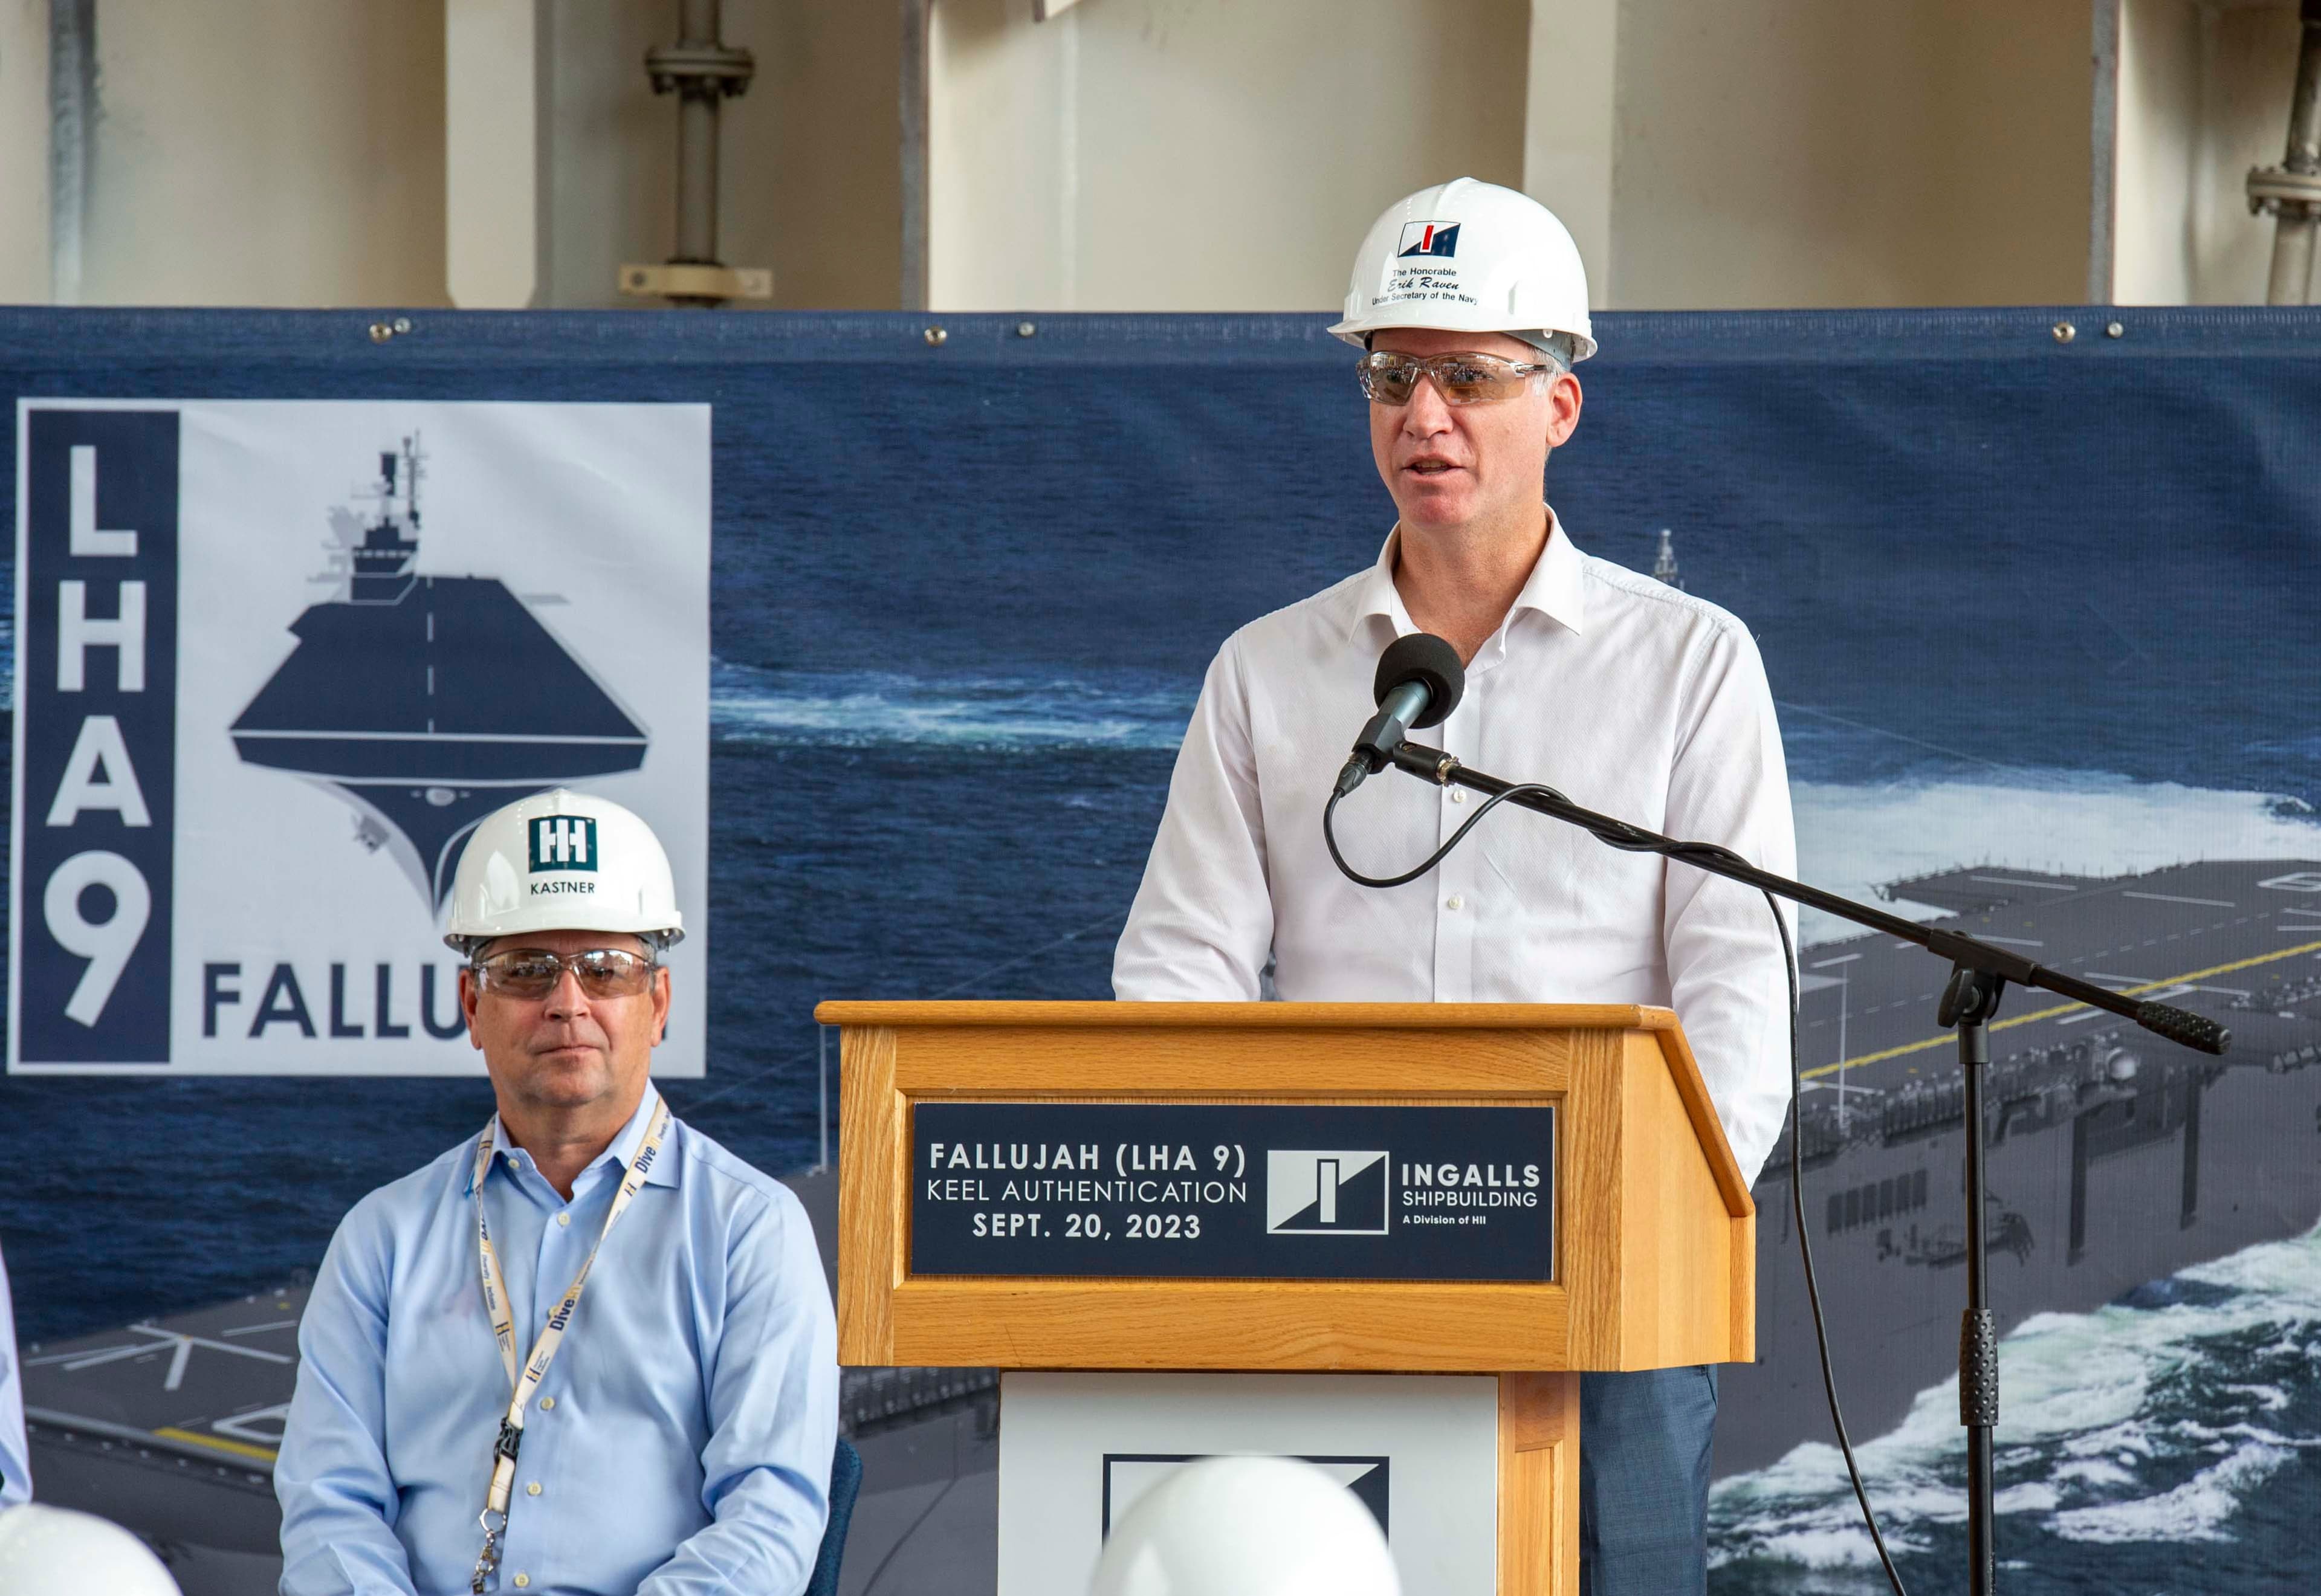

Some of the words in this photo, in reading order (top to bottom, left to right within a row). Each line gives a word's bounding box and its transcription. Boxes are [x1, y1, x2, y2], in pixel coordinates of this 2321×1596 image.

[1410, 267, 1457, 276] Honorable
[1387, 277, 1414, 292] Erik
[1419, 276, 1460, 290] Raven
[1372, 295, 1390, 305] Under
[1391, 291, 1427, 301] Secretary
[1458, 294, 1479, 305] Navy
[531, 882, 595, 896] KASTNER
[930, 1143, 1098, 1170] FALLUJAH
[1116, 1143, 1197, 1177] (LHA
[1213, 1145, 1245, 1178] 9)
[1402, 1163, 1540, 1187] INGALLS
[928, 1179, 989, 1201] KEEL
[1001, 1180, 1246, 1203] AUTHENTICATION
[1402, 1191, 1538, 1207] SHIPBUILDING
[973, 1212, 1050, 1238] SEPT.
[1065, 1213, 1111, 1241] 20,
[1125, 1214, 1200, 1239] 2023
[1402, 1215, 1411, 1224] A
[1413, 1215, 1455, 1224] Division
[1458, 1215, 1469, 1224] of
[1472, 1215, 1486, 1224] HII
